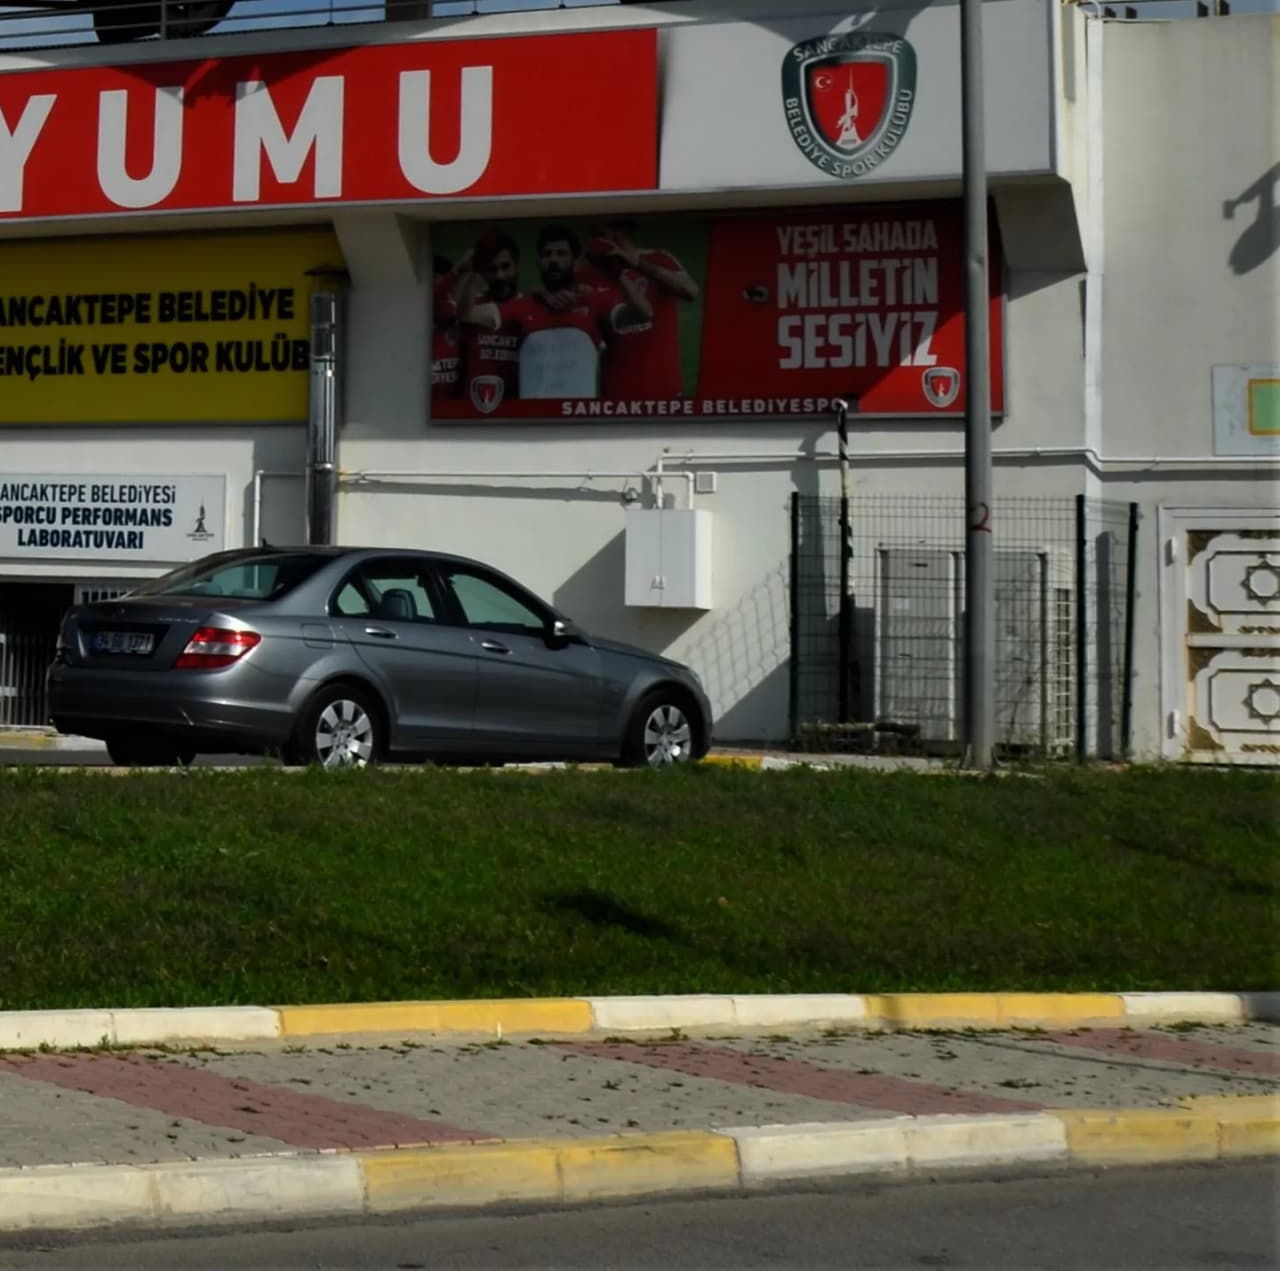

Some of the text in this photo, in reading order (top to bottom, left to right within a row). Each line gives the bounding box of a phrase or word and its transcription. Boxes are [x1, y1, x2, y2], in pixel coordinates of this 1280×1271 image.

[832, 155, 878, 177] SPOR
[843, 220, 938, 254] SAHADA
[158, 282, 295, 323] BELEDİYE
[91, 342, 126, 375] VE
[134, 340, 208, 373] SPOR
[215, 331, 312, 372] KULÜB
[561, 397, 848, 415] SANCAKTEPE BELEDİYESPO
[61, 507, 173, 527] PERFORMANS
[17, 529, 144, 550] LABORATUVARI
